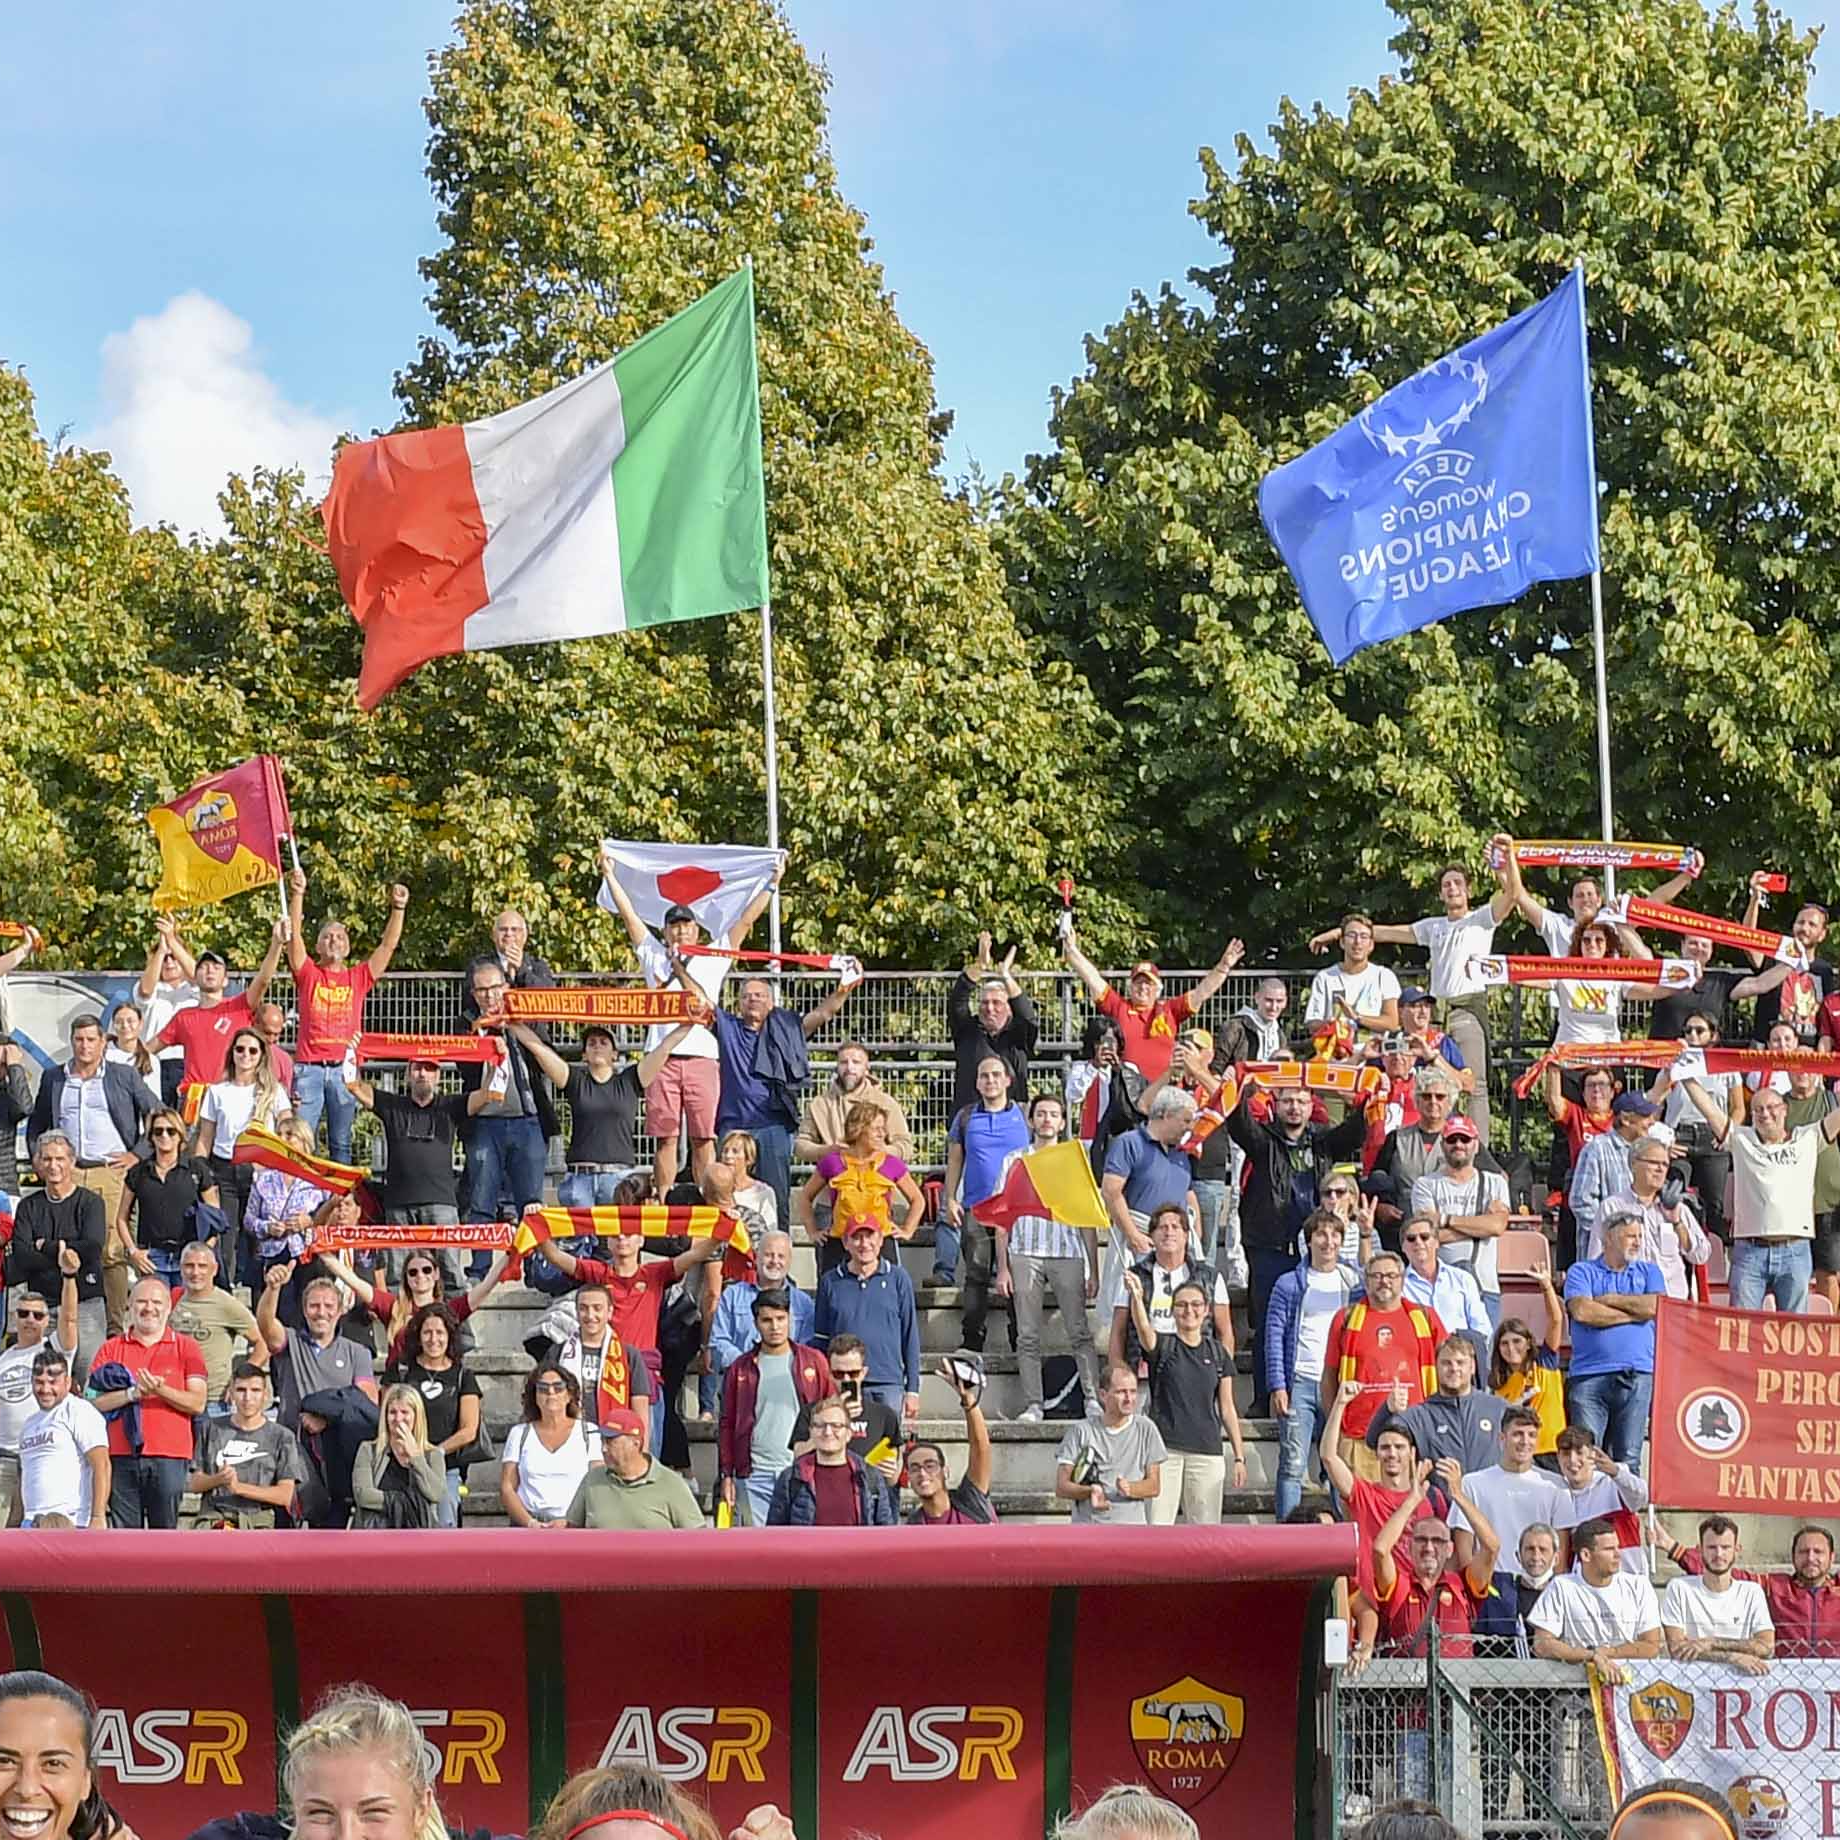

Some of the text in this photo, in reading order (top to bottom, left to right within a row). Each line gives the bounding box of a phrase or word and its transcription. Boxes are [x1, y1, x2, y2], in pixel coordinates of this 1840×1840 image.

[594, 991, 646, 1015] INSIEME
[650, 991, 660, 1014] A
[663, 991, 680, 1014] TE
[1716, 1317, 1751, 1353] TI
[90, 1708, 248, 1785] ASR
[598, 1706, 772, 1783] ASR
[843, 1705, 1024, 1782] ASR
[1148, 1749, 1225, 1770] ROMA
[1171, 1776, 1201, 1790] 1927
